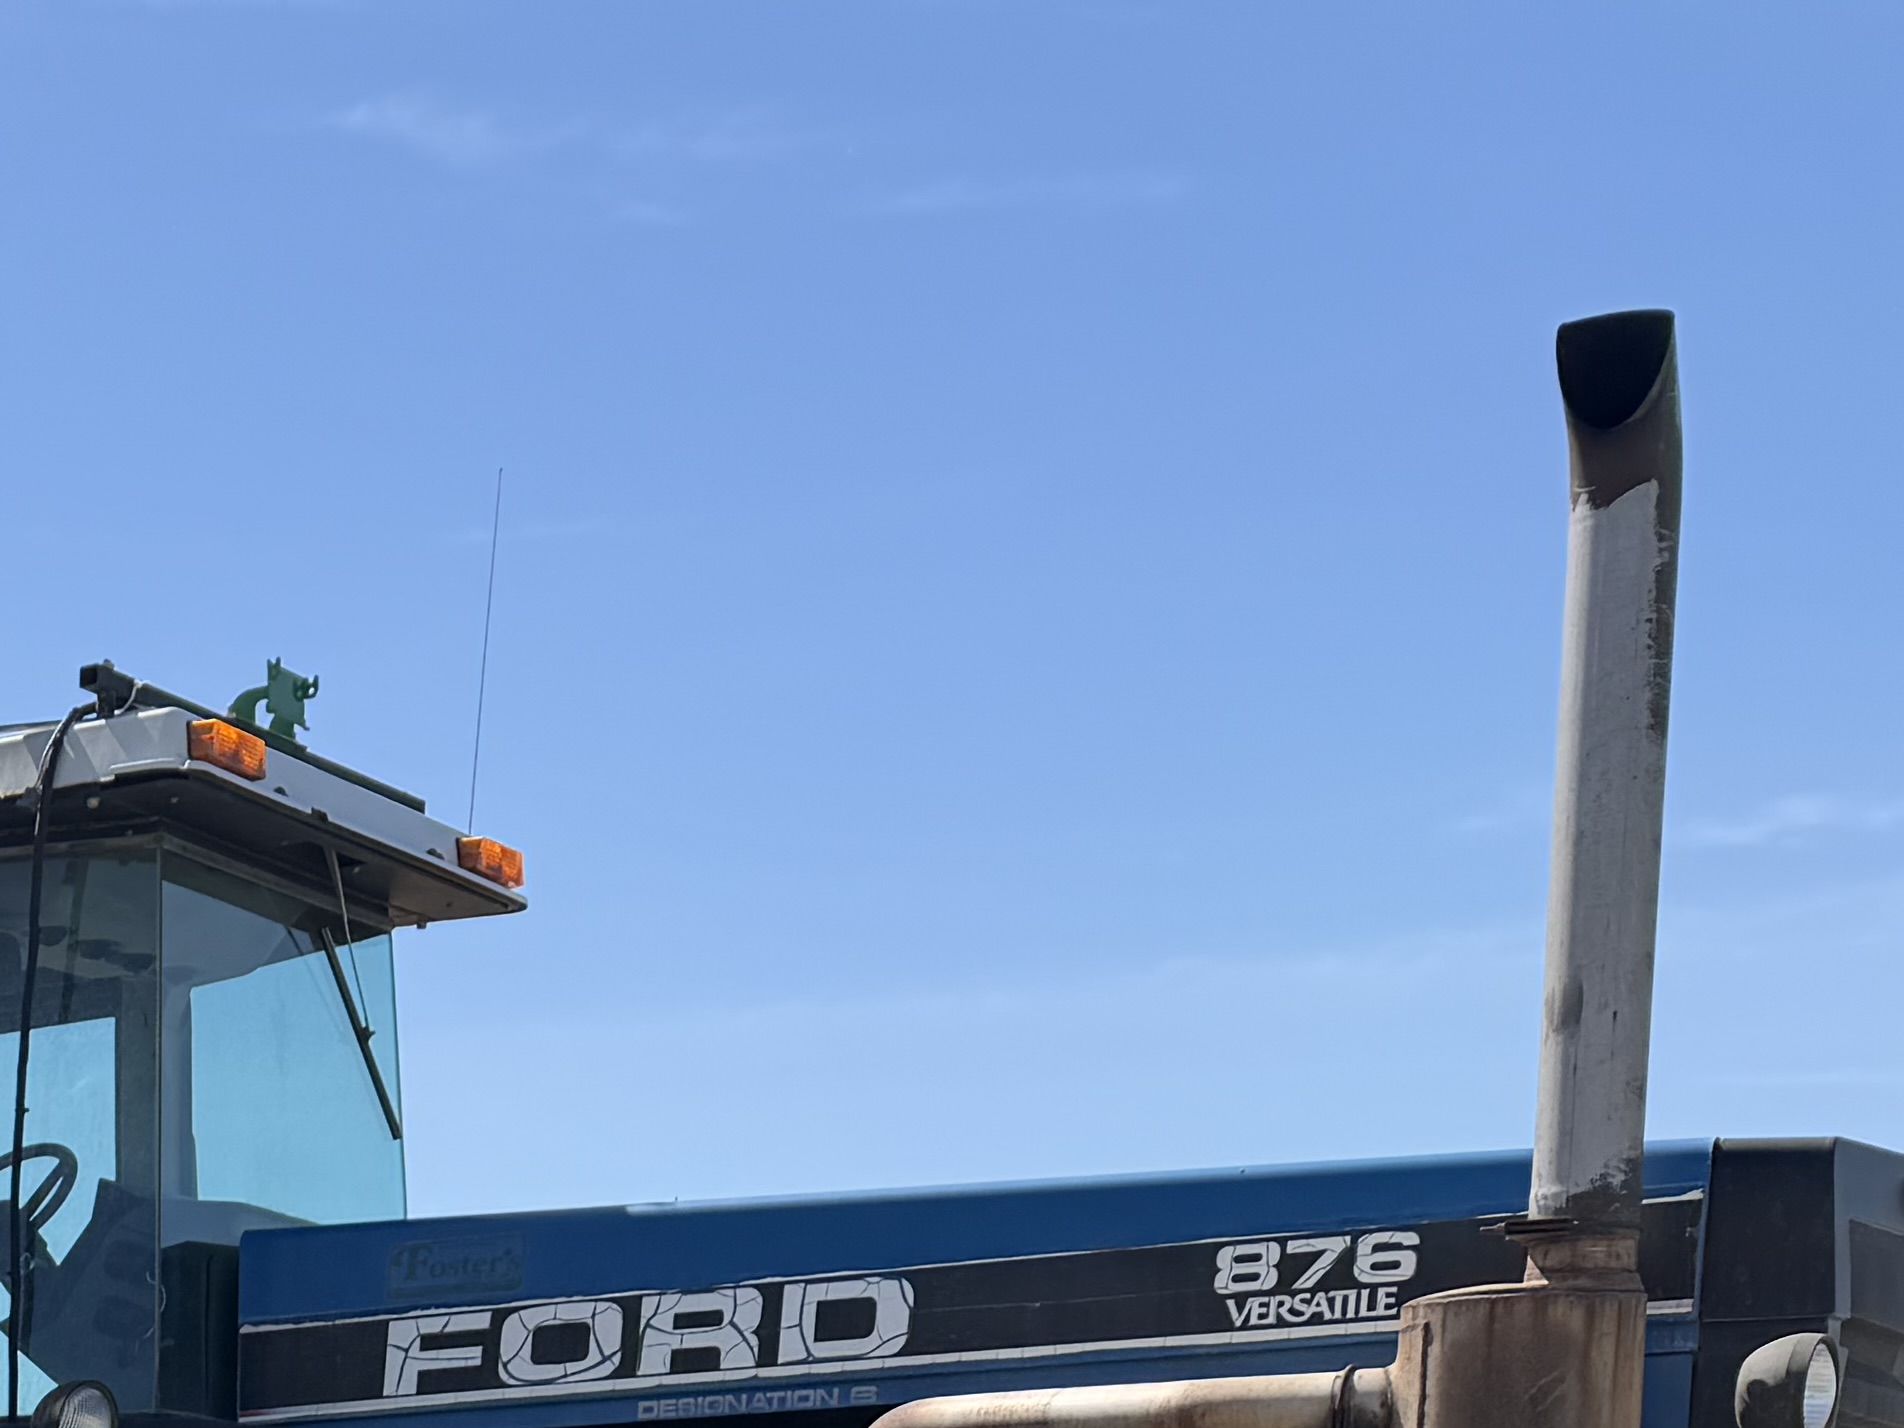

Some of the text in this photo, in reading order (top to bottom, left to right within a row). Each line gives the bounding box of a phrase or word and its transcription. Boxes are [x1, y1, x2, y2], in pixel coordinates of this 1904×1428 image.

[391, 1243, 522, 1282] Foster's
[1213, 1231, 1421, 1295] 876
[1225, 1286, 1399, 1329] VERSATILE
[383, 1276, 915, 1397] FORD
[637, 1388, 840, 1420] DESIGNATION
